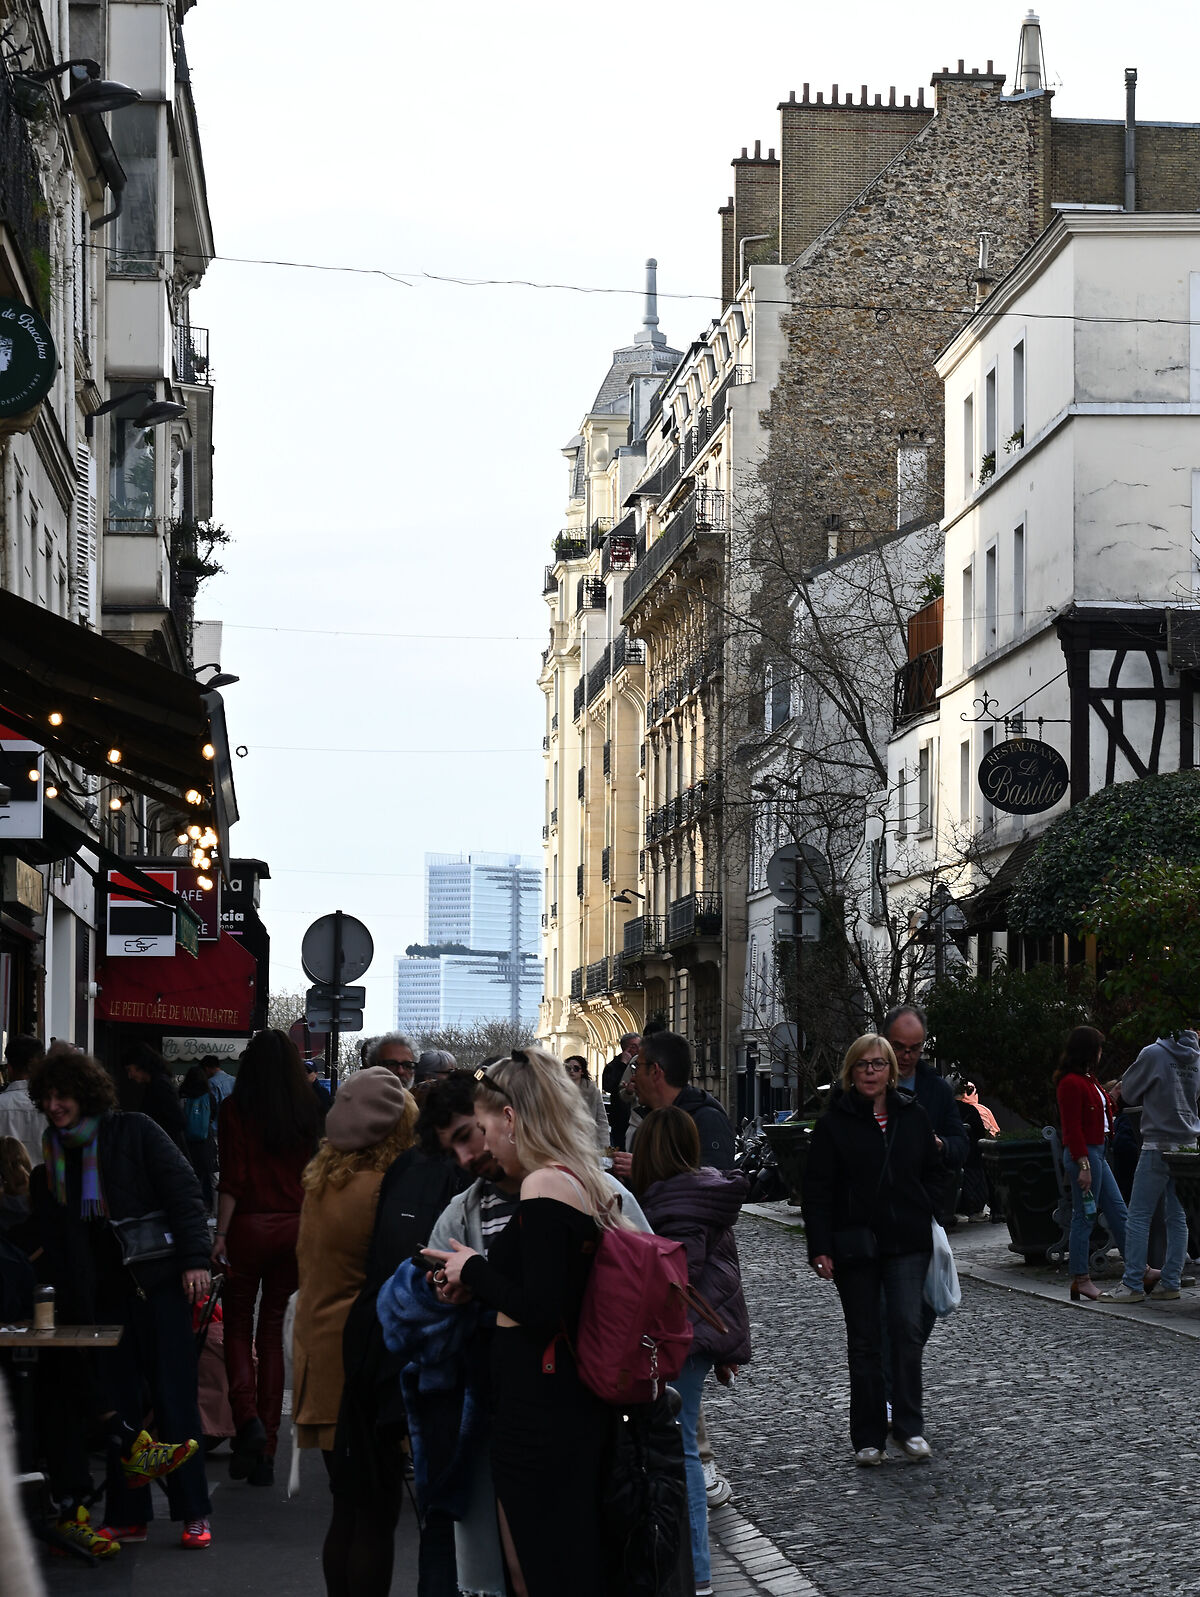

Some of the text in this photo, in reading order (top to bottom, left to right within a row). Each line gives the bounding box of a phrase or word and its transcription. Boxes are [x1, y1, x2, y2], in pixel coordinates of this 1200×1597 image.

[1, 308, 48, 360] de Bacchus
[986, 742, 1062, 766] RESTAURANT
[1017, 759, 1040, 776] Le
[986, 765, 1062, 806] Basilic
[110, 1000, 121, 1016] LE
[122, 1001, 146, 1017] PETIT
[169, 1004, 181, 1020] DE
[183, 1006, 240, 1025] MONTMARTRE
[184, 1038, 236, 1055] Bossue
